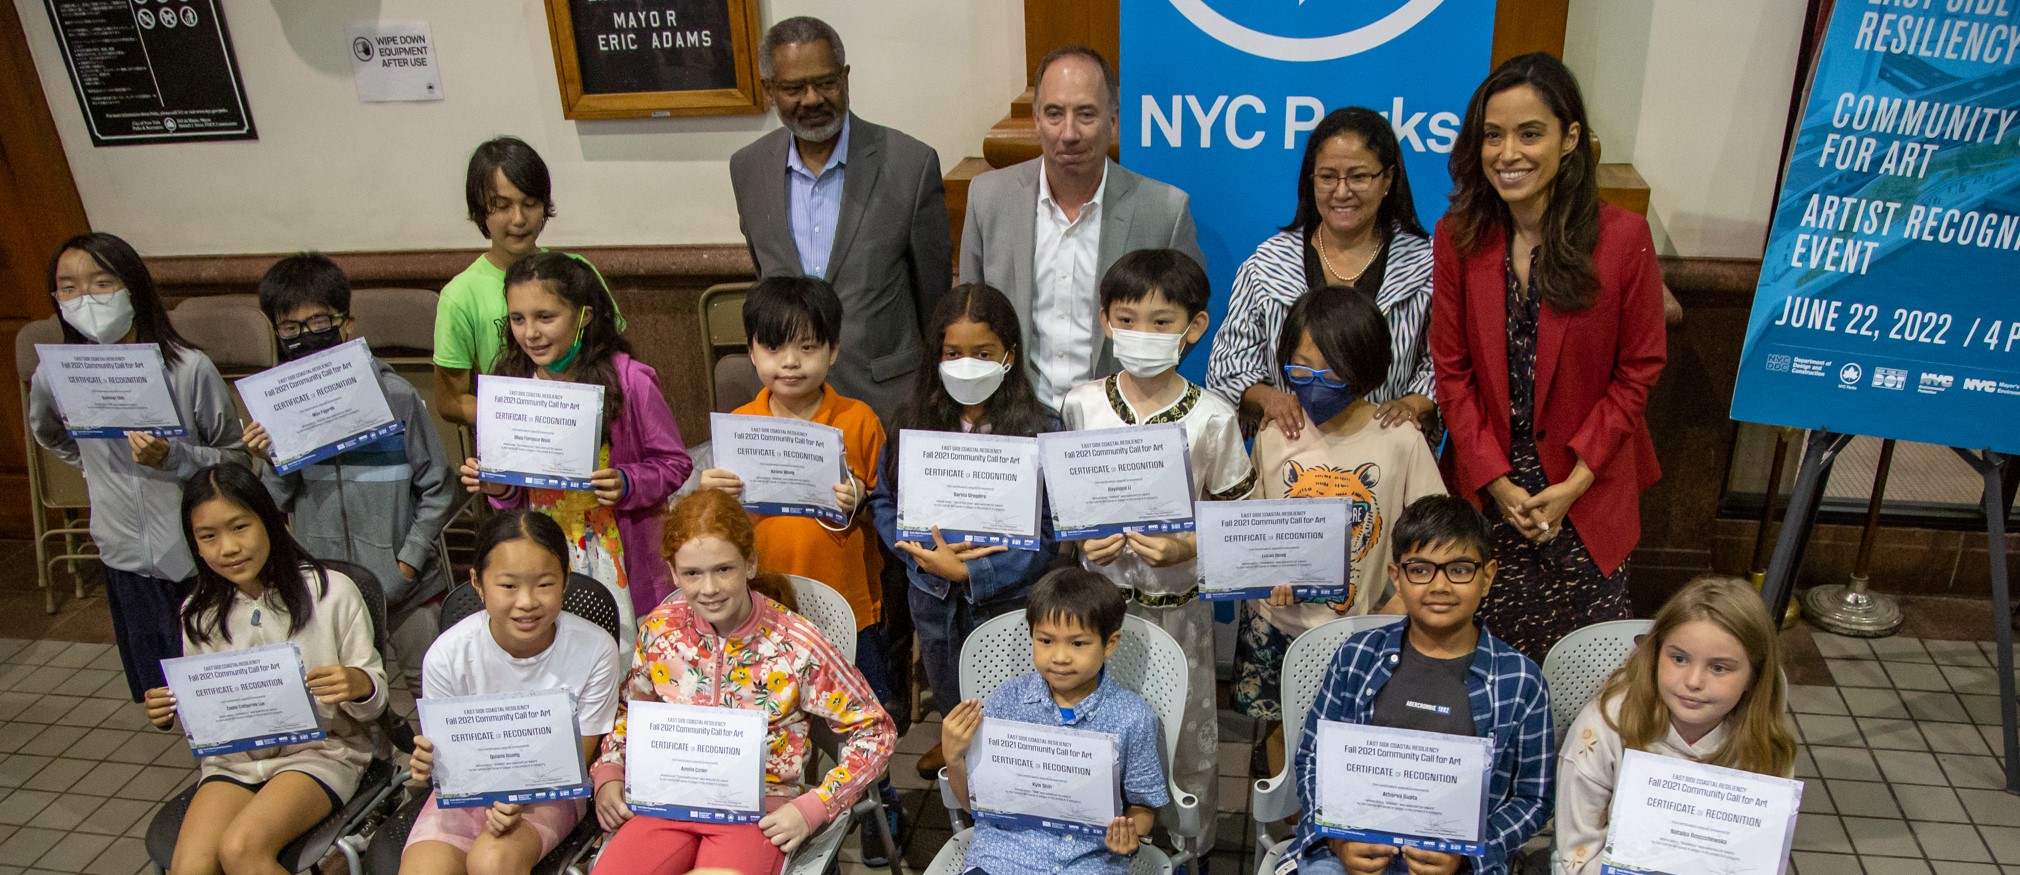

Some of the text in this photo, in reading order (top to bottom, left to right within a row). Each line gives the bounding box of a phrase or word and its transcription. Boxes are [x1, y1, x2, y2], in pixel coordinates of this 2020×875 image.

[375, 35, 426, 45] WIPE DOWN
[598, 30, 712, 51] ERIC ADAMS
[1855, 12, 2020, 65] RESILIENCY
[379, 47, 428, 56] EQUIPMENT
[382, 58, 428, 67] AFTER USE
[1141, 94, 1461, 154] NYC Pks
[1832, 92, 2018, 145] COMMUNITY
[1819, 134, 1940, 179] FOR ART
[1801, 194, 1901, 236] ARTIST
[1791, 234, 1879, 275] EVENT
[1775, 296, 1842, 332] JUNE
[1845, 303, 1878, 342] 22,
[1889, 309, 1952, 345] 2022
[1963, 318, 1981, 348] /
[1984, 320, 2002, 350] 4
[1767, 354, 1791, 365] NYC
[1794, 357, 1825, 365] Department
[275, 385, 289, 394] 2021
[289, 375, 322, 390] Community
[321, 369, 333, 378] Call
[342, 362, 352, 370] Art
[1792, 368, 1825, 376] Construction
[1920, 372, 1954, 387] NYC
[1963, 378, 1996, 393] NYC
[274, 377, 357, 411] CERTIFICATE RECOGNITION
[516, 398, 547, 407] Community
[496, 412, 576, 426] CERTIFICATE RECOGNITION
[760, 434, 794, 443] Community
[738, 448, 823, 462] CERTIFICATE RECOGNITION
[950, 453, 986, 463] Community
[1092, 448, 1128, 457] Community
[925, 468, 1017, 481] CERTIFICATE RECOGNITION
[1070, 461, 1164, 475] CERTIFICATE RECOGNITION
[1224, 532, 1323, 542] CERTIFICATE RECOGNITION
[215, 668, 248, 678] Community
[196, 678, 283, 696] CERTIFICATE RECOGNITION
[459, 716, 474, 724] 2021
[476, 714, 514, 723] Community
[452, 727, 552, 742] CERTIFICATE RECOGNITION
[676, 725, 710, 736] Community
[651, 740, 740, 755] CERTIFICATE RECOGNITION
[988, 738, 1092, 759] Fall 2021 Community Call for Art
[1344, 745, 1461, 766] Fall 2021 Community Call for Art
[992, 755, 1090, 776] CERTIFICATE RECOGNITION
[1346, 763, 1458, 784] CERTIFICATE RECOGNITION
[1648, 777, 1768, 808] Fall 2021 Community Call for Art
[1647, 798, 1761, 827] CERTIFICATE RECOGNITION
